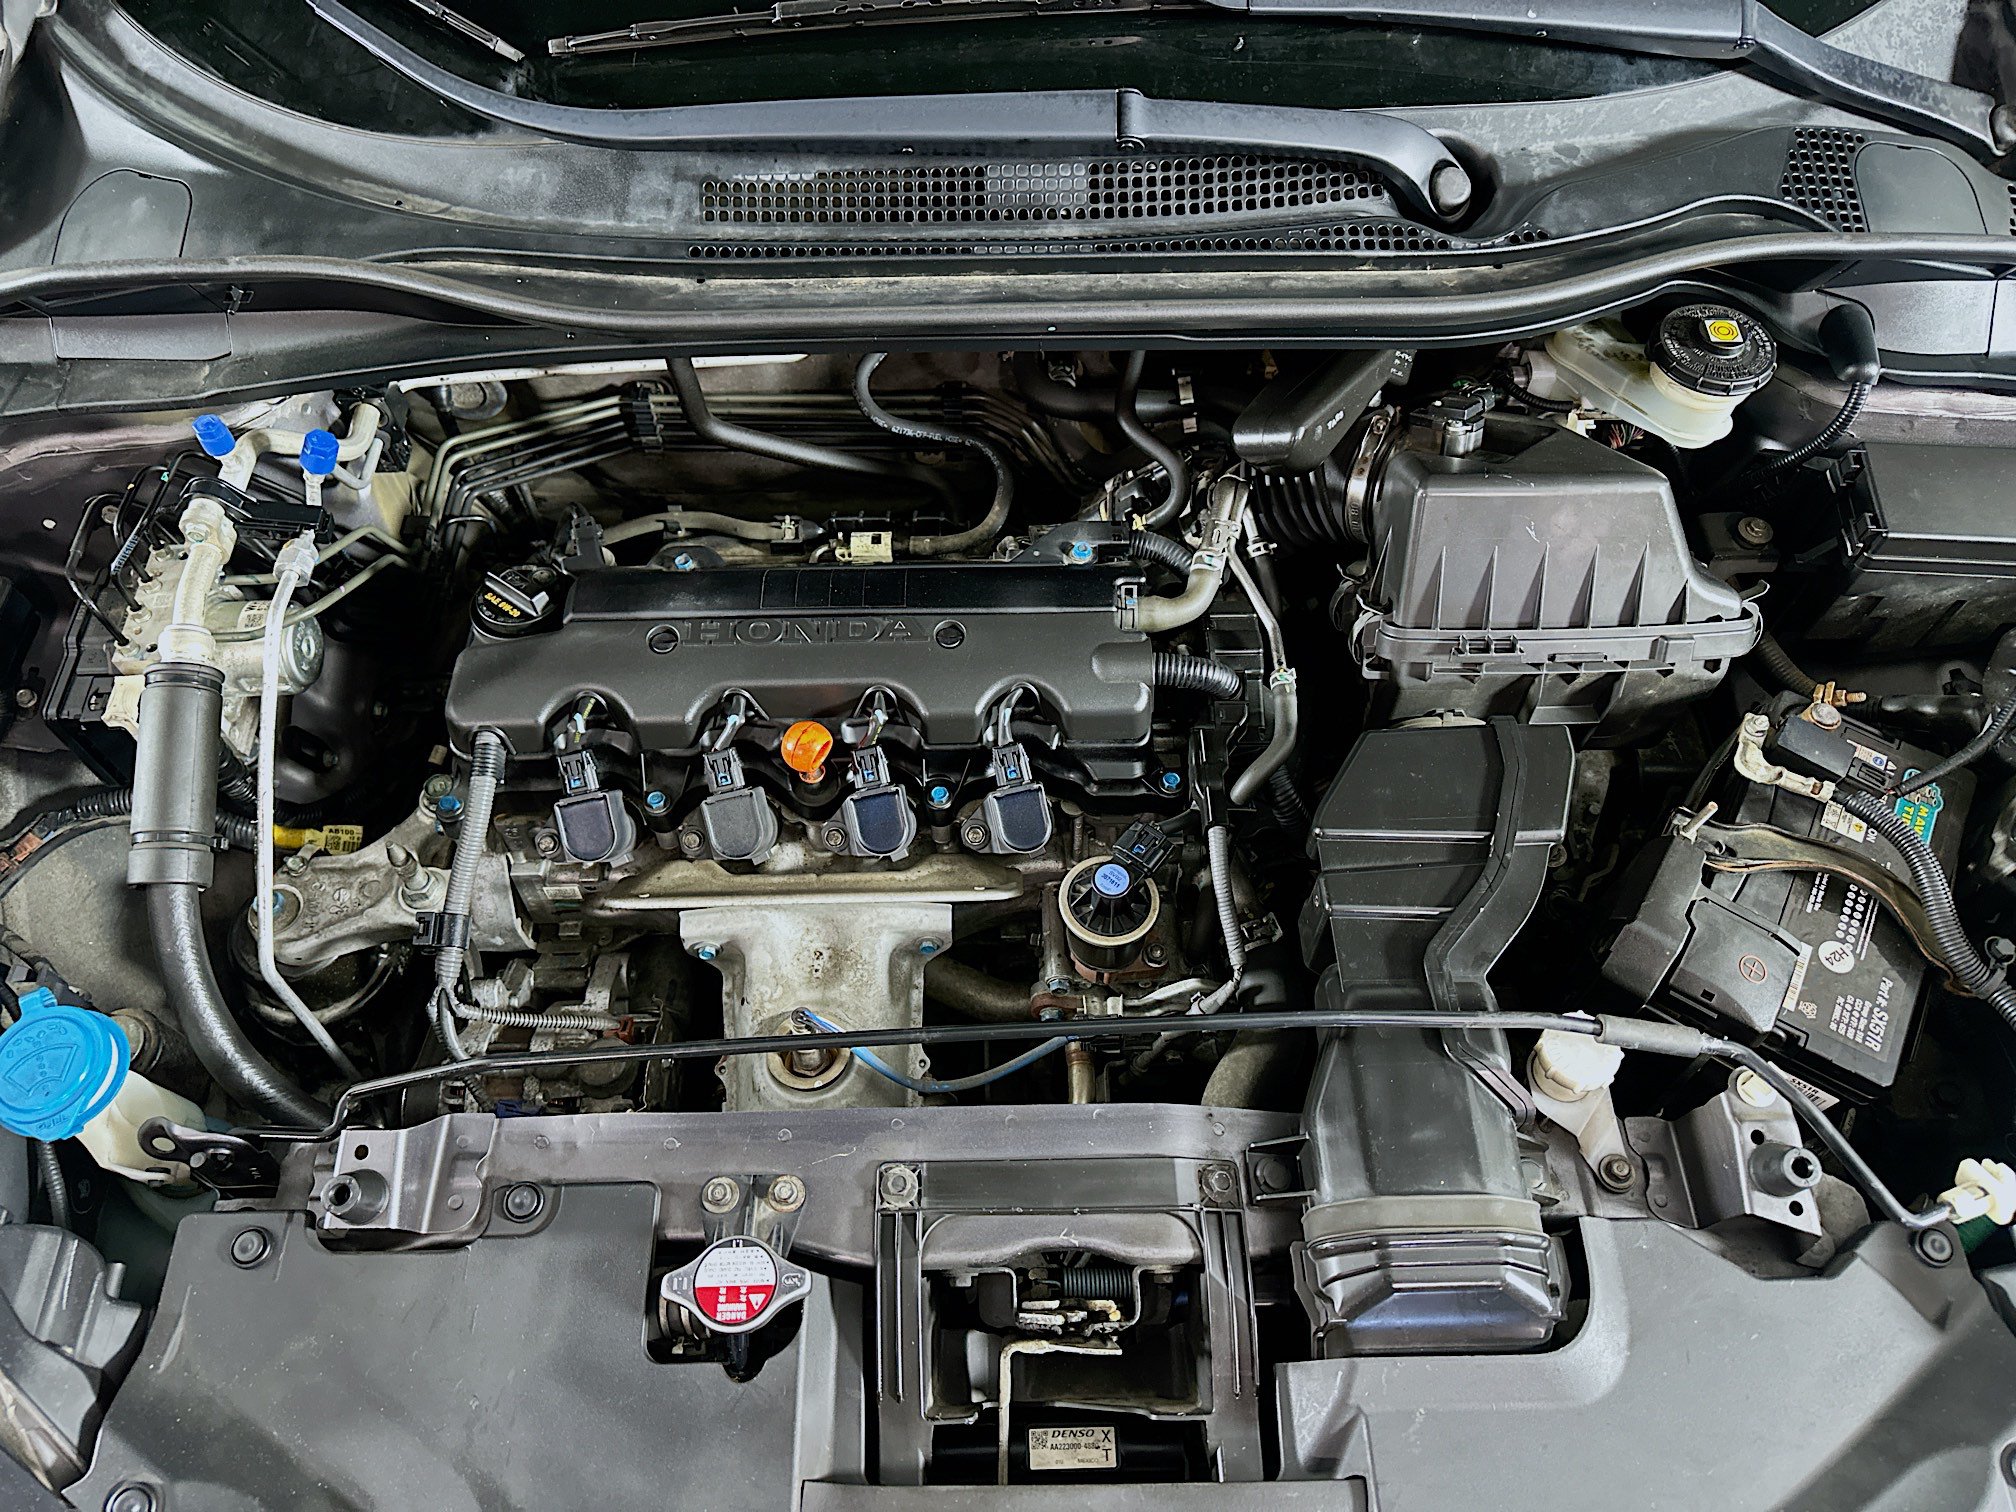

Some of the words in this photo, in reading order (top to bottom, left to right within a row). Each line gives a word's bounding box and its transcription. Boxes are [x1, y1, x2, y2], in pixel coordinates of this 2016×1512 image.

[484, 592, 502, 606] SAE
[681, 617, 931, 647] HONDA
[1914, 804, 1930, 837] MAV
[1824, 947, 1850, 966] H24
[1877, 977, 1894, 999] Part
[1846, 994, 1855, 1005] CA
[1854, 998, 1864, 1012] CCA
[1864, 1007, 1889, 1052] SX51R
[1790, 1078, 1819, 1094] SX51R
[716, 1311, 747, 1321] DANGER
[1051, 1428, 1095, 1439] DENSO
[1101, 1429, 1112, 1443] X
[1102, 1448, 1112, 1462] T
